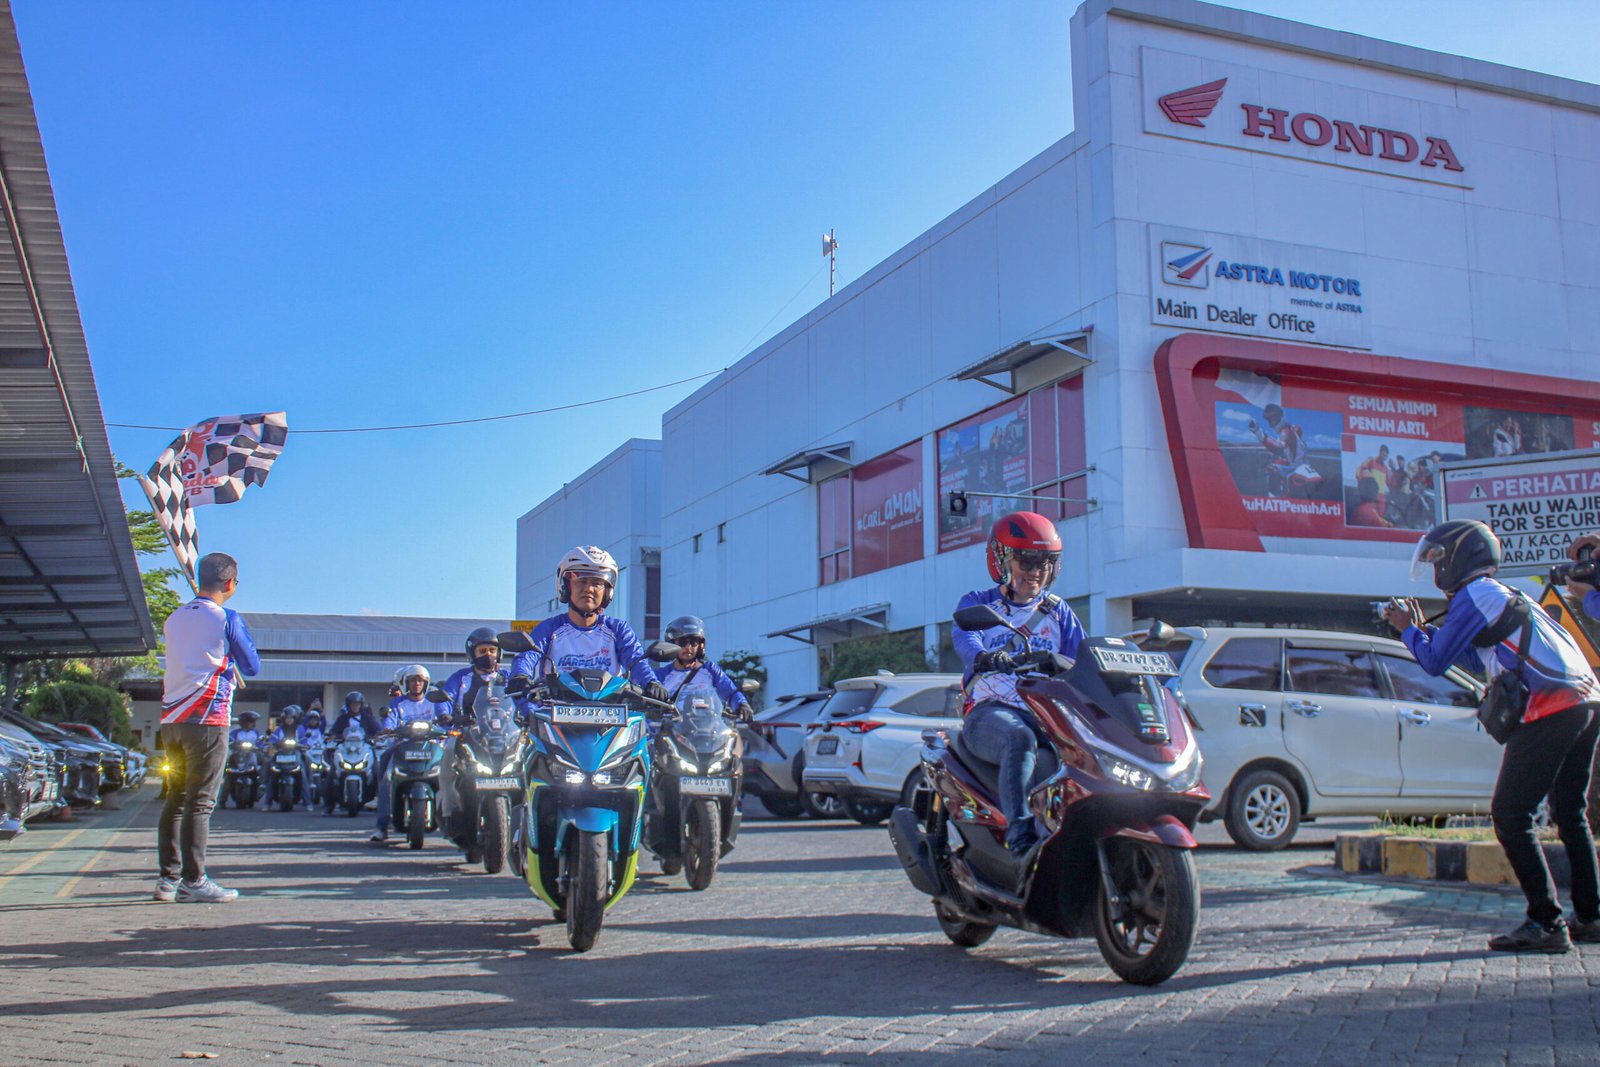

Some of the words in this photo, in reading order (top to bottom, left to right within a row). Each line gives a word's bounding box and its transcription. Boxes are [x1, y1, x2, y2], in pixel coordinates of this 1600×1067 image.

[1241, 103, 1464, 172] HONDA
[1215, 261, 1284, 287] ASTRA
[1289, 270, 1361, 296] MOTOR
[1290, 298, 1323, 309] member
[1324, 301, 1333, 310] of
[1335, 302, 1362, 314] ASTRA
[1157, 298, 1198, 320] Main
[1206, 304, 1258, 327] Dealer
[1268, 312, 1315, 334] Office
[1348, 395, 1395, 413] SEMUA
[1397, 400, 1437, 417] MIMPI
[1349, 415, 1395, 433] PENUH
[1397, 420, 1429, 438] ARTI,
[1486, 500, 1540, 518] TAMU
[1484, 517, 1527, 532] POR
[1529, 533, 1573, 548] KACA
[1500, 549, 1545, 564] ARAP
[1100, 651, 1118, 663] DR
[1120, 653, 1148, 665] 2767
[1150, 655, 1167, 666] EV
[558, 706, 571, 716] DR
[575, 707, 601, 717] 3937
